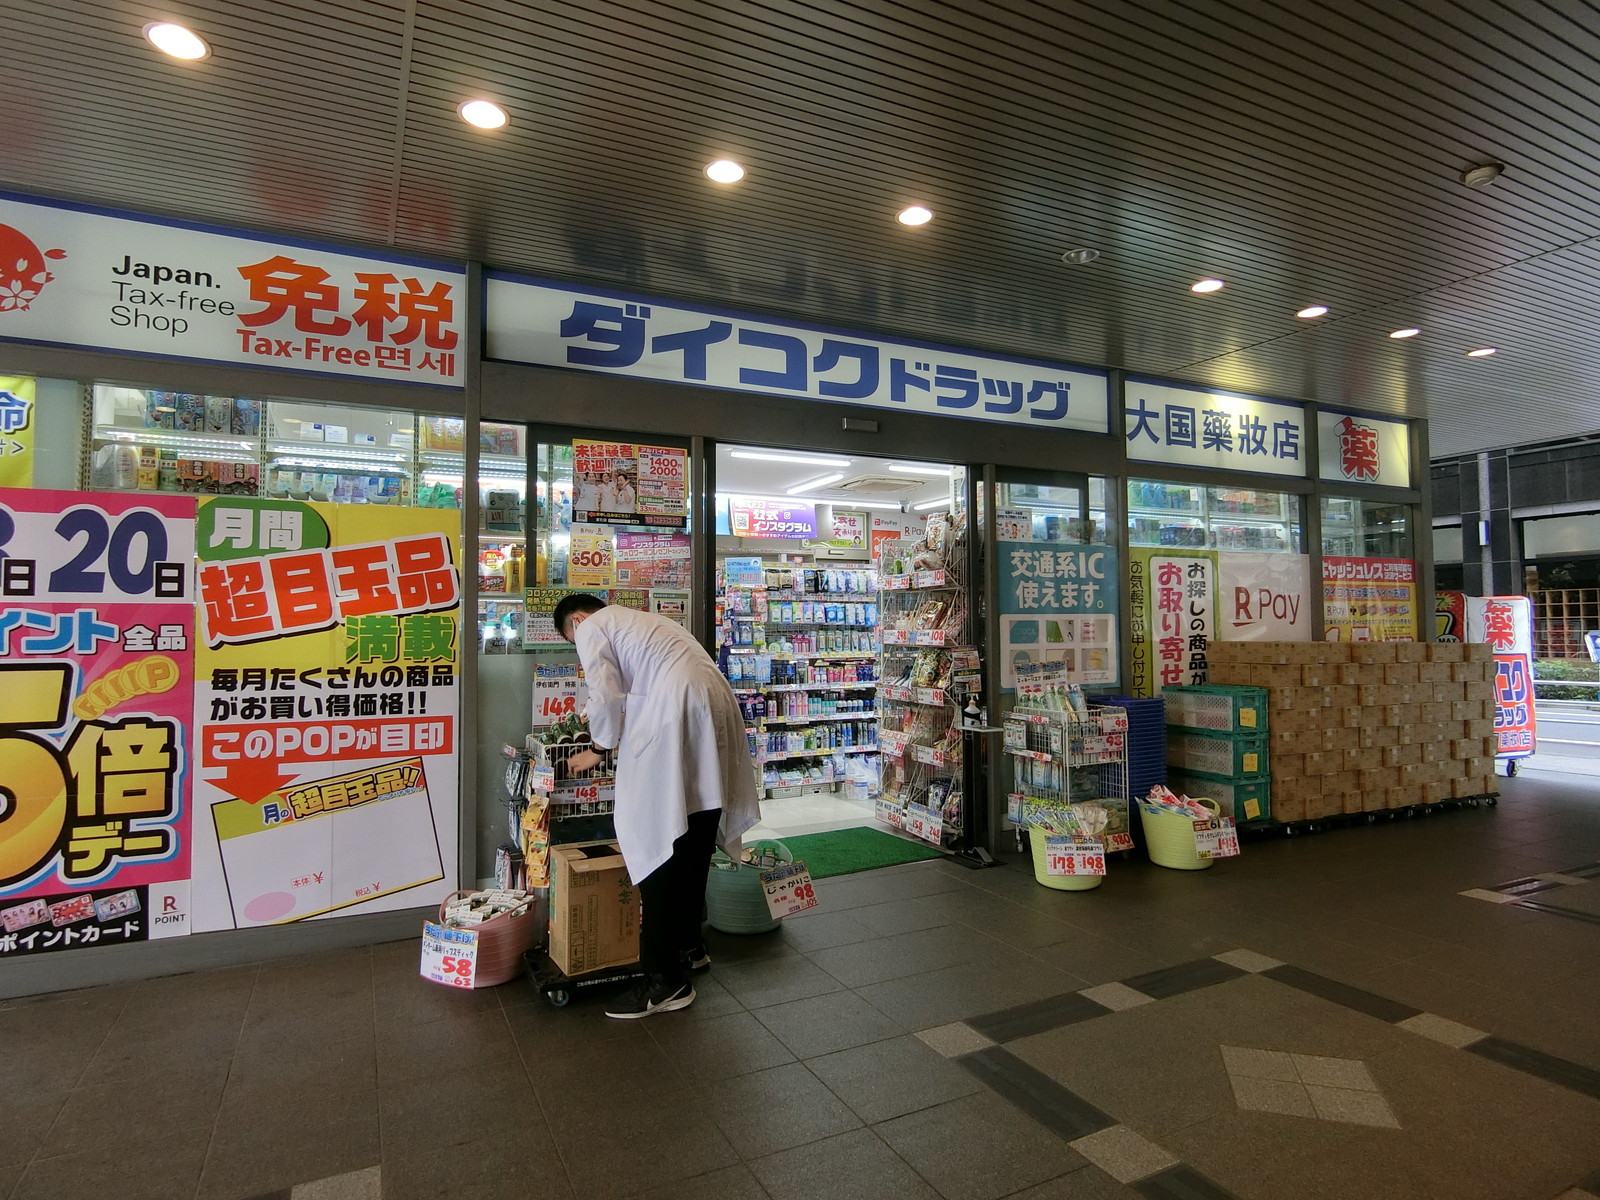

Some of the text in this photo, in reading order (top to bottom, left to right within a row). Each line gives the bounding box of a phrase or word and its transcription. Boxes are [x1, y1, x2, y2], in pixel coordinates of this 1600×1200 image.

[112, 256, 221, 289] Japan.
[111, 281, 235, 317] Tax-free
[236, 255, 459, 349] 免税
[110, 306, 189, 337] Shop
[560, 300, 1071, 421] ダイコクドラッグ
[576, 445, 633, 458] 未経験者
[210, 507, 303, 550] 月間
[753, 521, 812, 532] インスタグラム
[1011, 549, 1105, 579] 交通系IC
[200, 537, 453, 636] 超目玉品
[1015, 580, 1104, 609] 使えます。
[1232, 586, 1300, 628] R Pay
[124, 624, 187, 652] 全品
[1157, 562, 1184, 686] お取り寄せ
[1187, 562, 1208, 686] お探しの商品が
[346, 615, 456, 663] 満載
[210, 665, 454, 693] 毎月たくさんの商品
[543, 696, 576, 716] 148
[1115, 719, 1127, 727] 98
[211, 726, 445, 760] このPOPが目印
[1106, 735, 1122, 746] 98
[576, 786, 597, 798] 148
[912, 819, 923, 831] 158
[1112, 834, 1131, 846] 980
[1052, 856, 1104, 869] 178 198
[293, 876, 310, 888] 本体
[767, 876, 810, 894] じゃがりこ
[794, 883, 815, 900] 98
[154, 913, 186, 925] POINT
[442, 955, 472, 977] 58
[453, 977, 471, 986] 63
